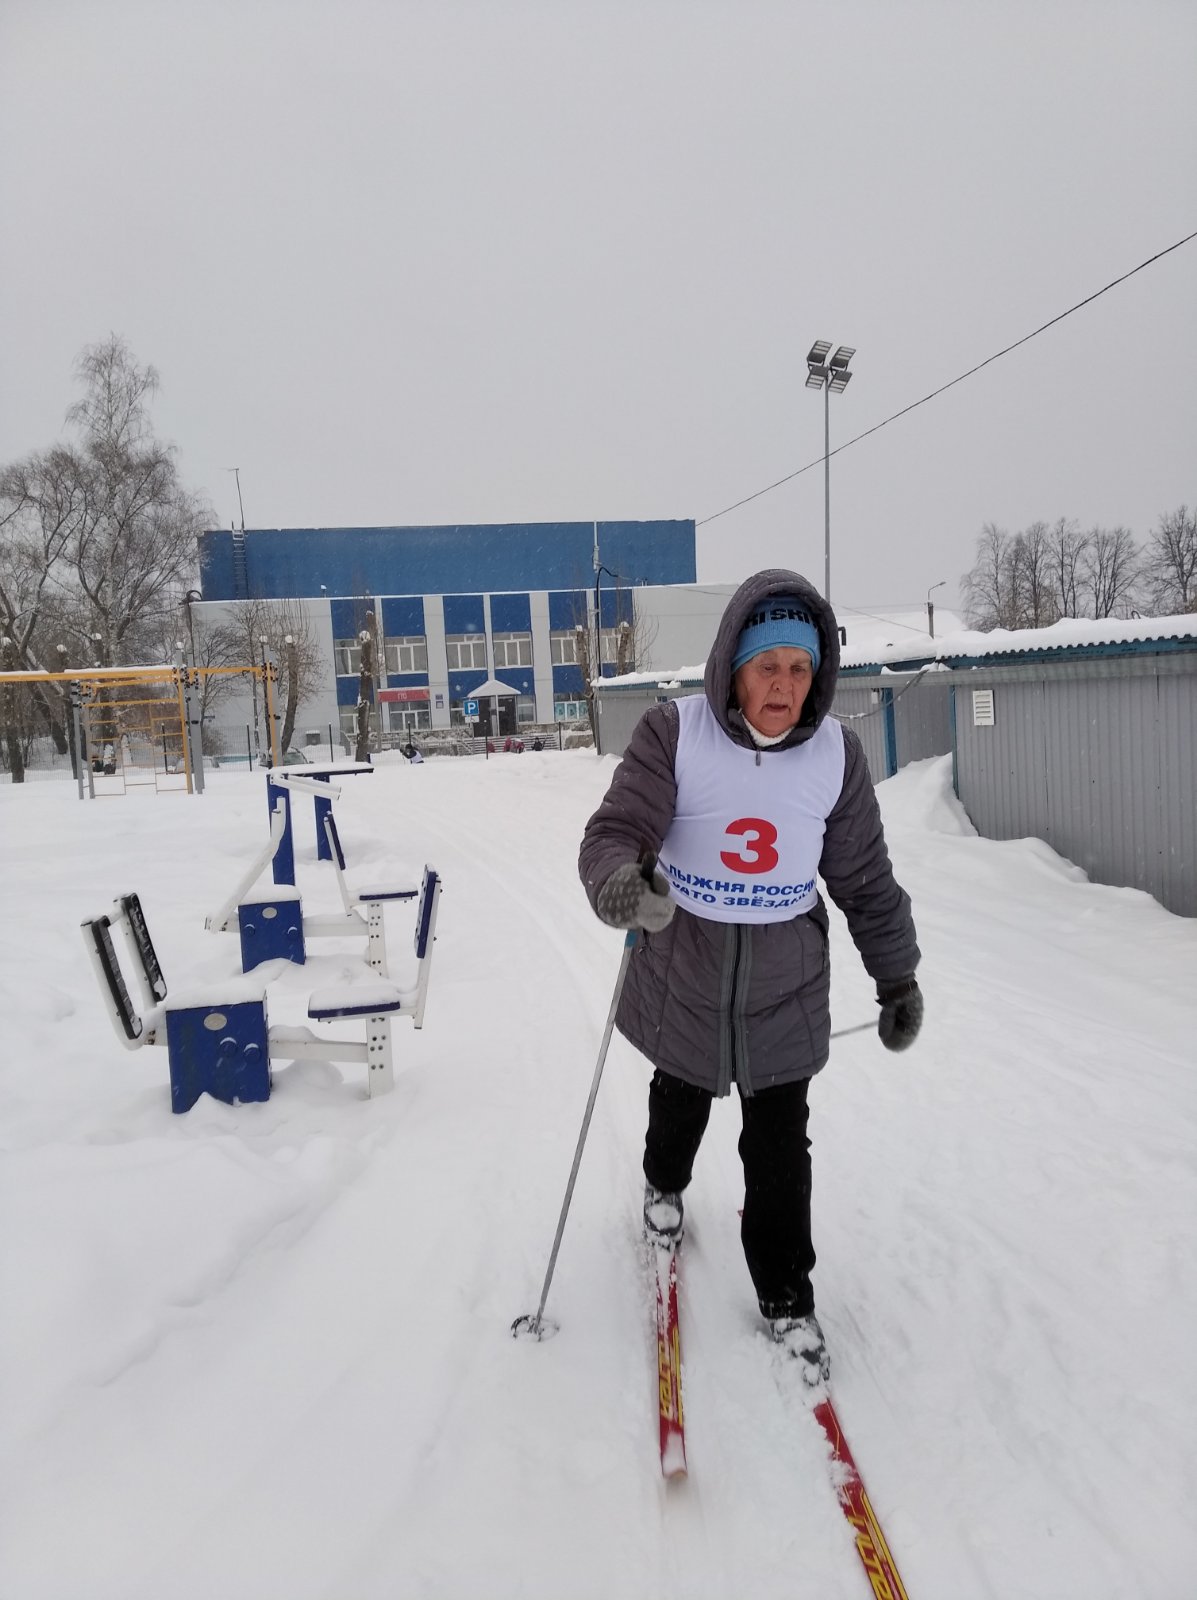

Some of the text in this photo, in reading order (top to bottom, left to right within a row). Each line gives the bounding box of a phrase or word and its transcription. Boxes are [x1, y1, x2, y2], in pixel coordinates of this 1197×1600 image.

[467, 702, 476, 714] P
[720, 817, 779, 874] 3
[669, 864, 745, 893] ЛЫЖНЯ
[723, 892, 808, 909] ЗВЁЗД
